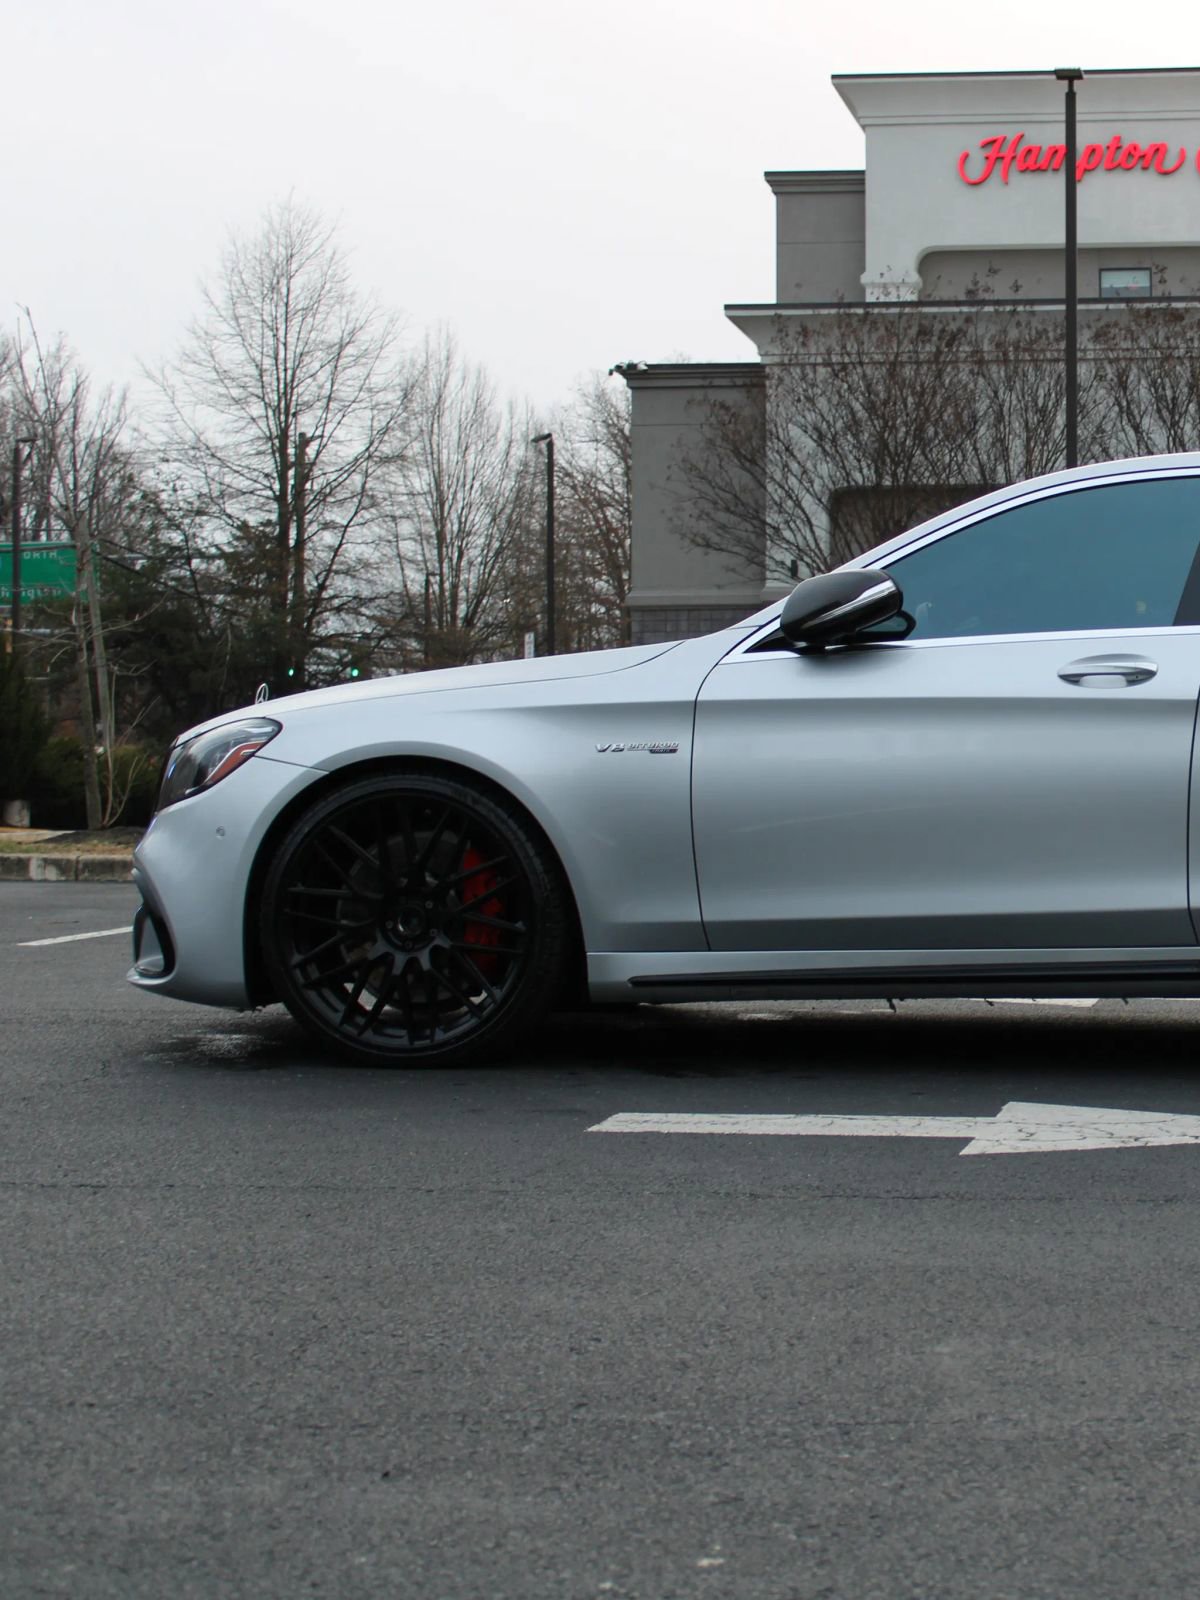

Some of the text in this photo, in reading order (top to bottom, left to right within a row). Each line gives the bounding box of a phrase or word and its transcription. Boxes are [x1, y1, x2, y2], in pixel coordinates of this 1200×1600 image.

[957, 131, 1187, 185] Hampton
[20, 550, 58, 560] ORTH
[595, 743, 625, 753] V8
